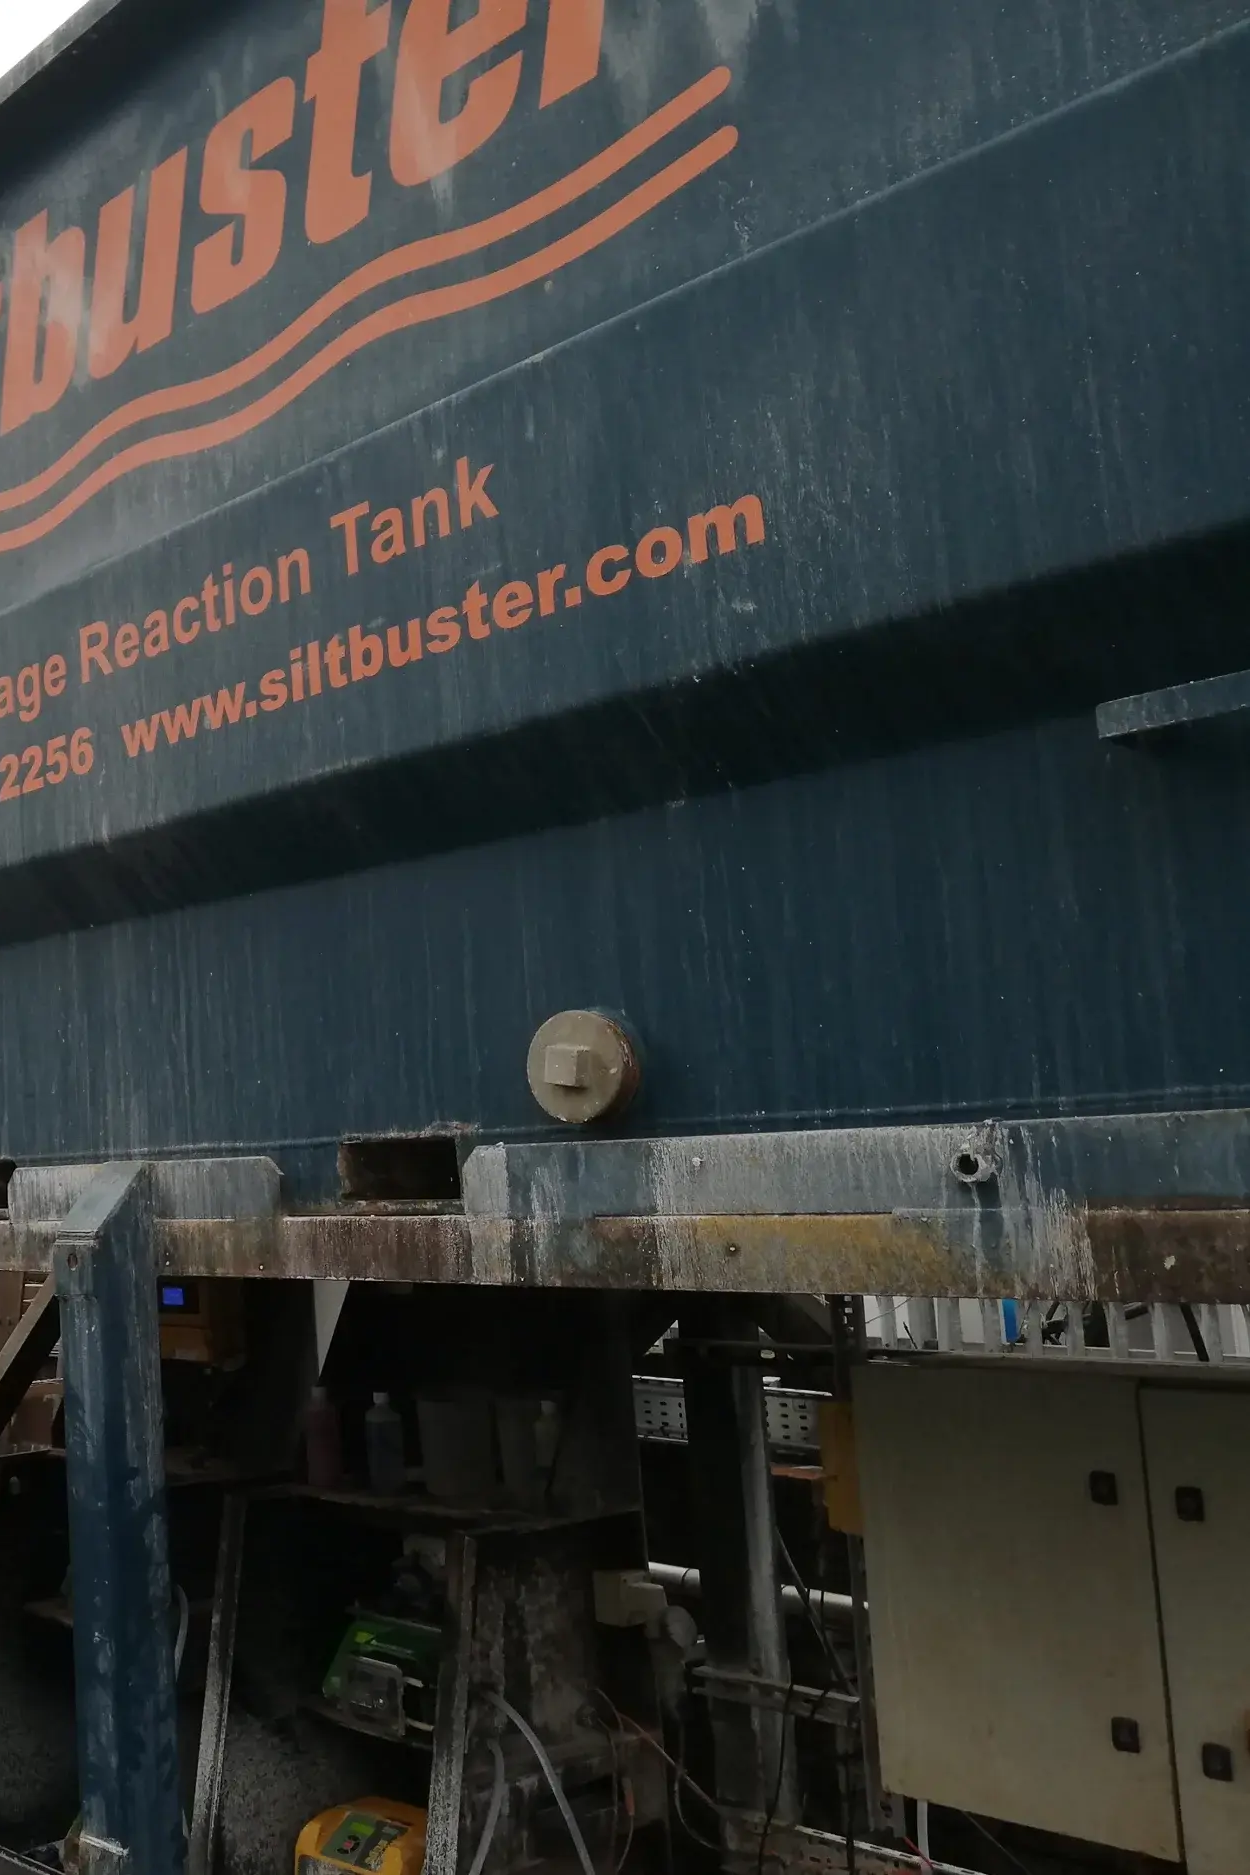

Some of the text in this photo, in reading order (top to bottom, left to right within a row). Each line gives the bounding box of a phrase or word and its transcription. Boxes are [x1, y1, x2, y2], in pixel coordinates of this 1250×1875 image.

[78, 547, 312, 684] Reaction
[329, 456, 499, 577] Tank
[120, 494, 766, 758] www.siltbuster.com
